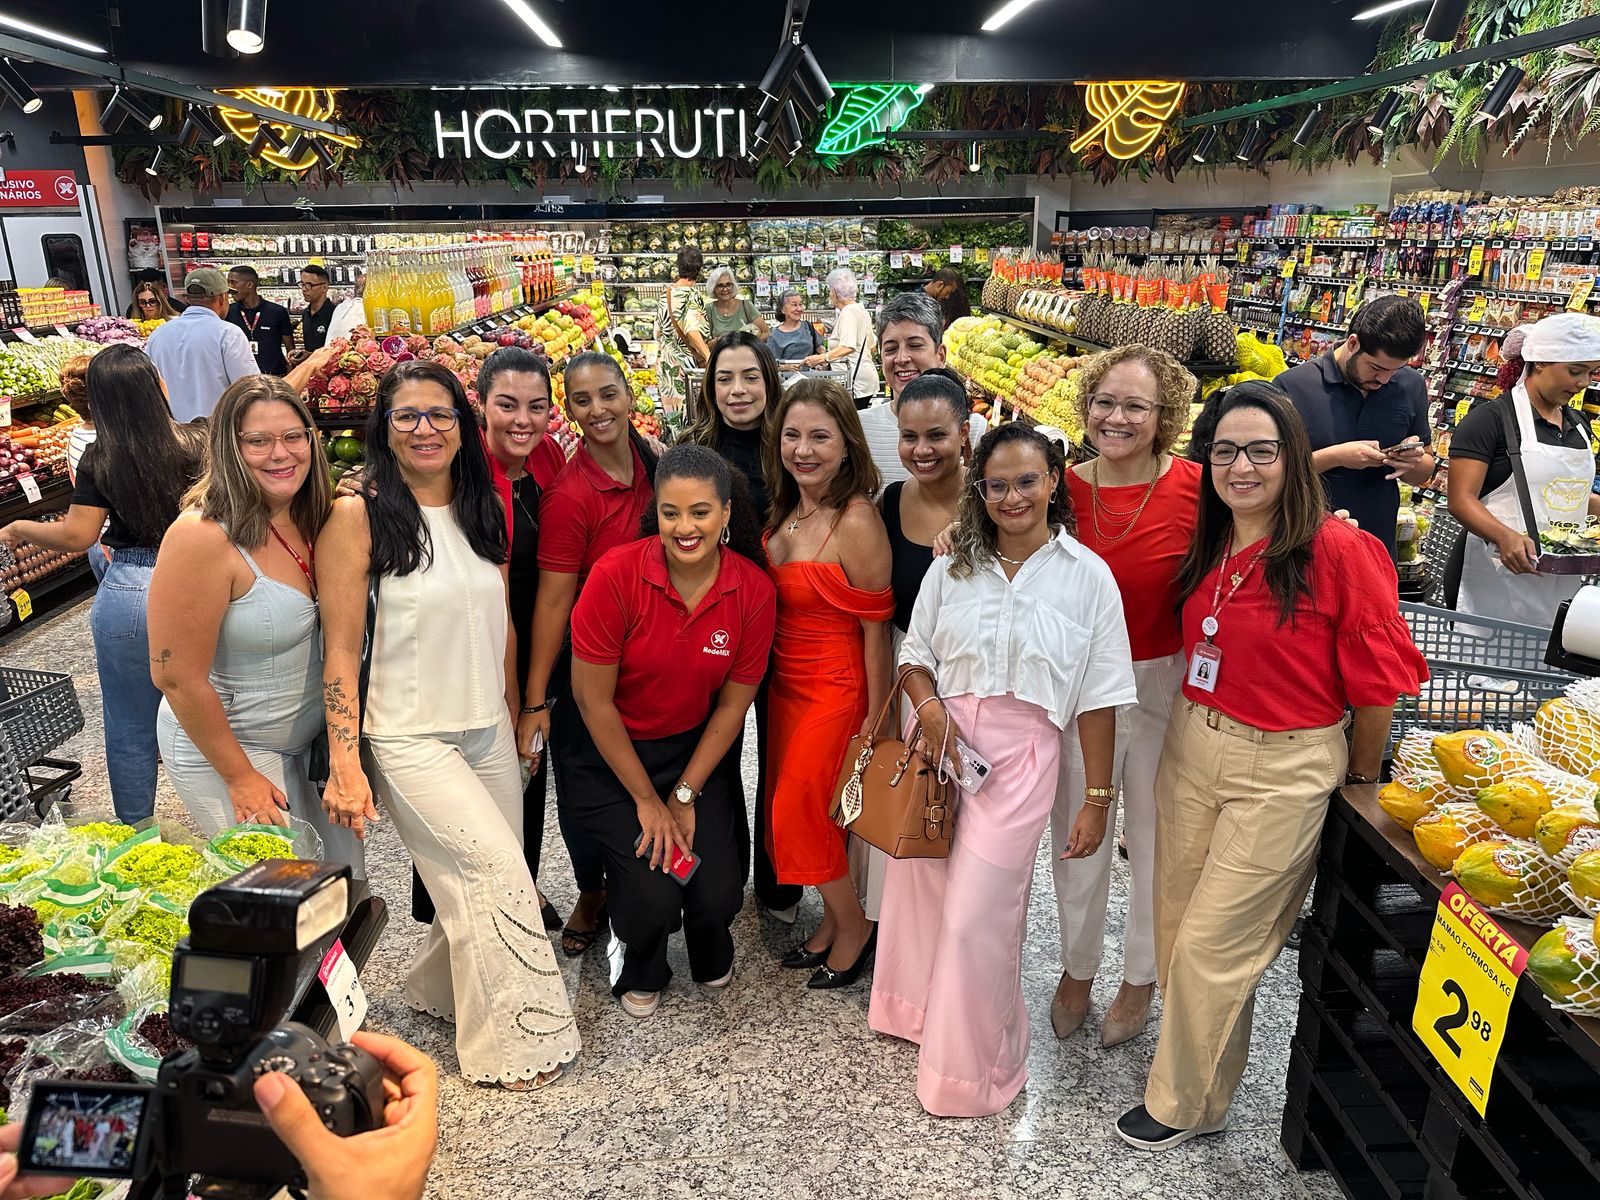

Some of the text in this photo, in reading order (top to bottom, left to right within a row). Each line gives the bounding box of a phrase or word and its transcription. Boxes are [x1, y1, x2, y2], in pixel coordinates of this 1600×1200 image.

[434, 108, 746, 159] HORTIFRUTI
[0, 179, 35, 189] USIVO
[0, 189, 42, 200] NÁRIOS
[1436, 914, 1511, 997] MAMAO FORMOSA KG
[1450, 893, 1519, 967] OFERTA
